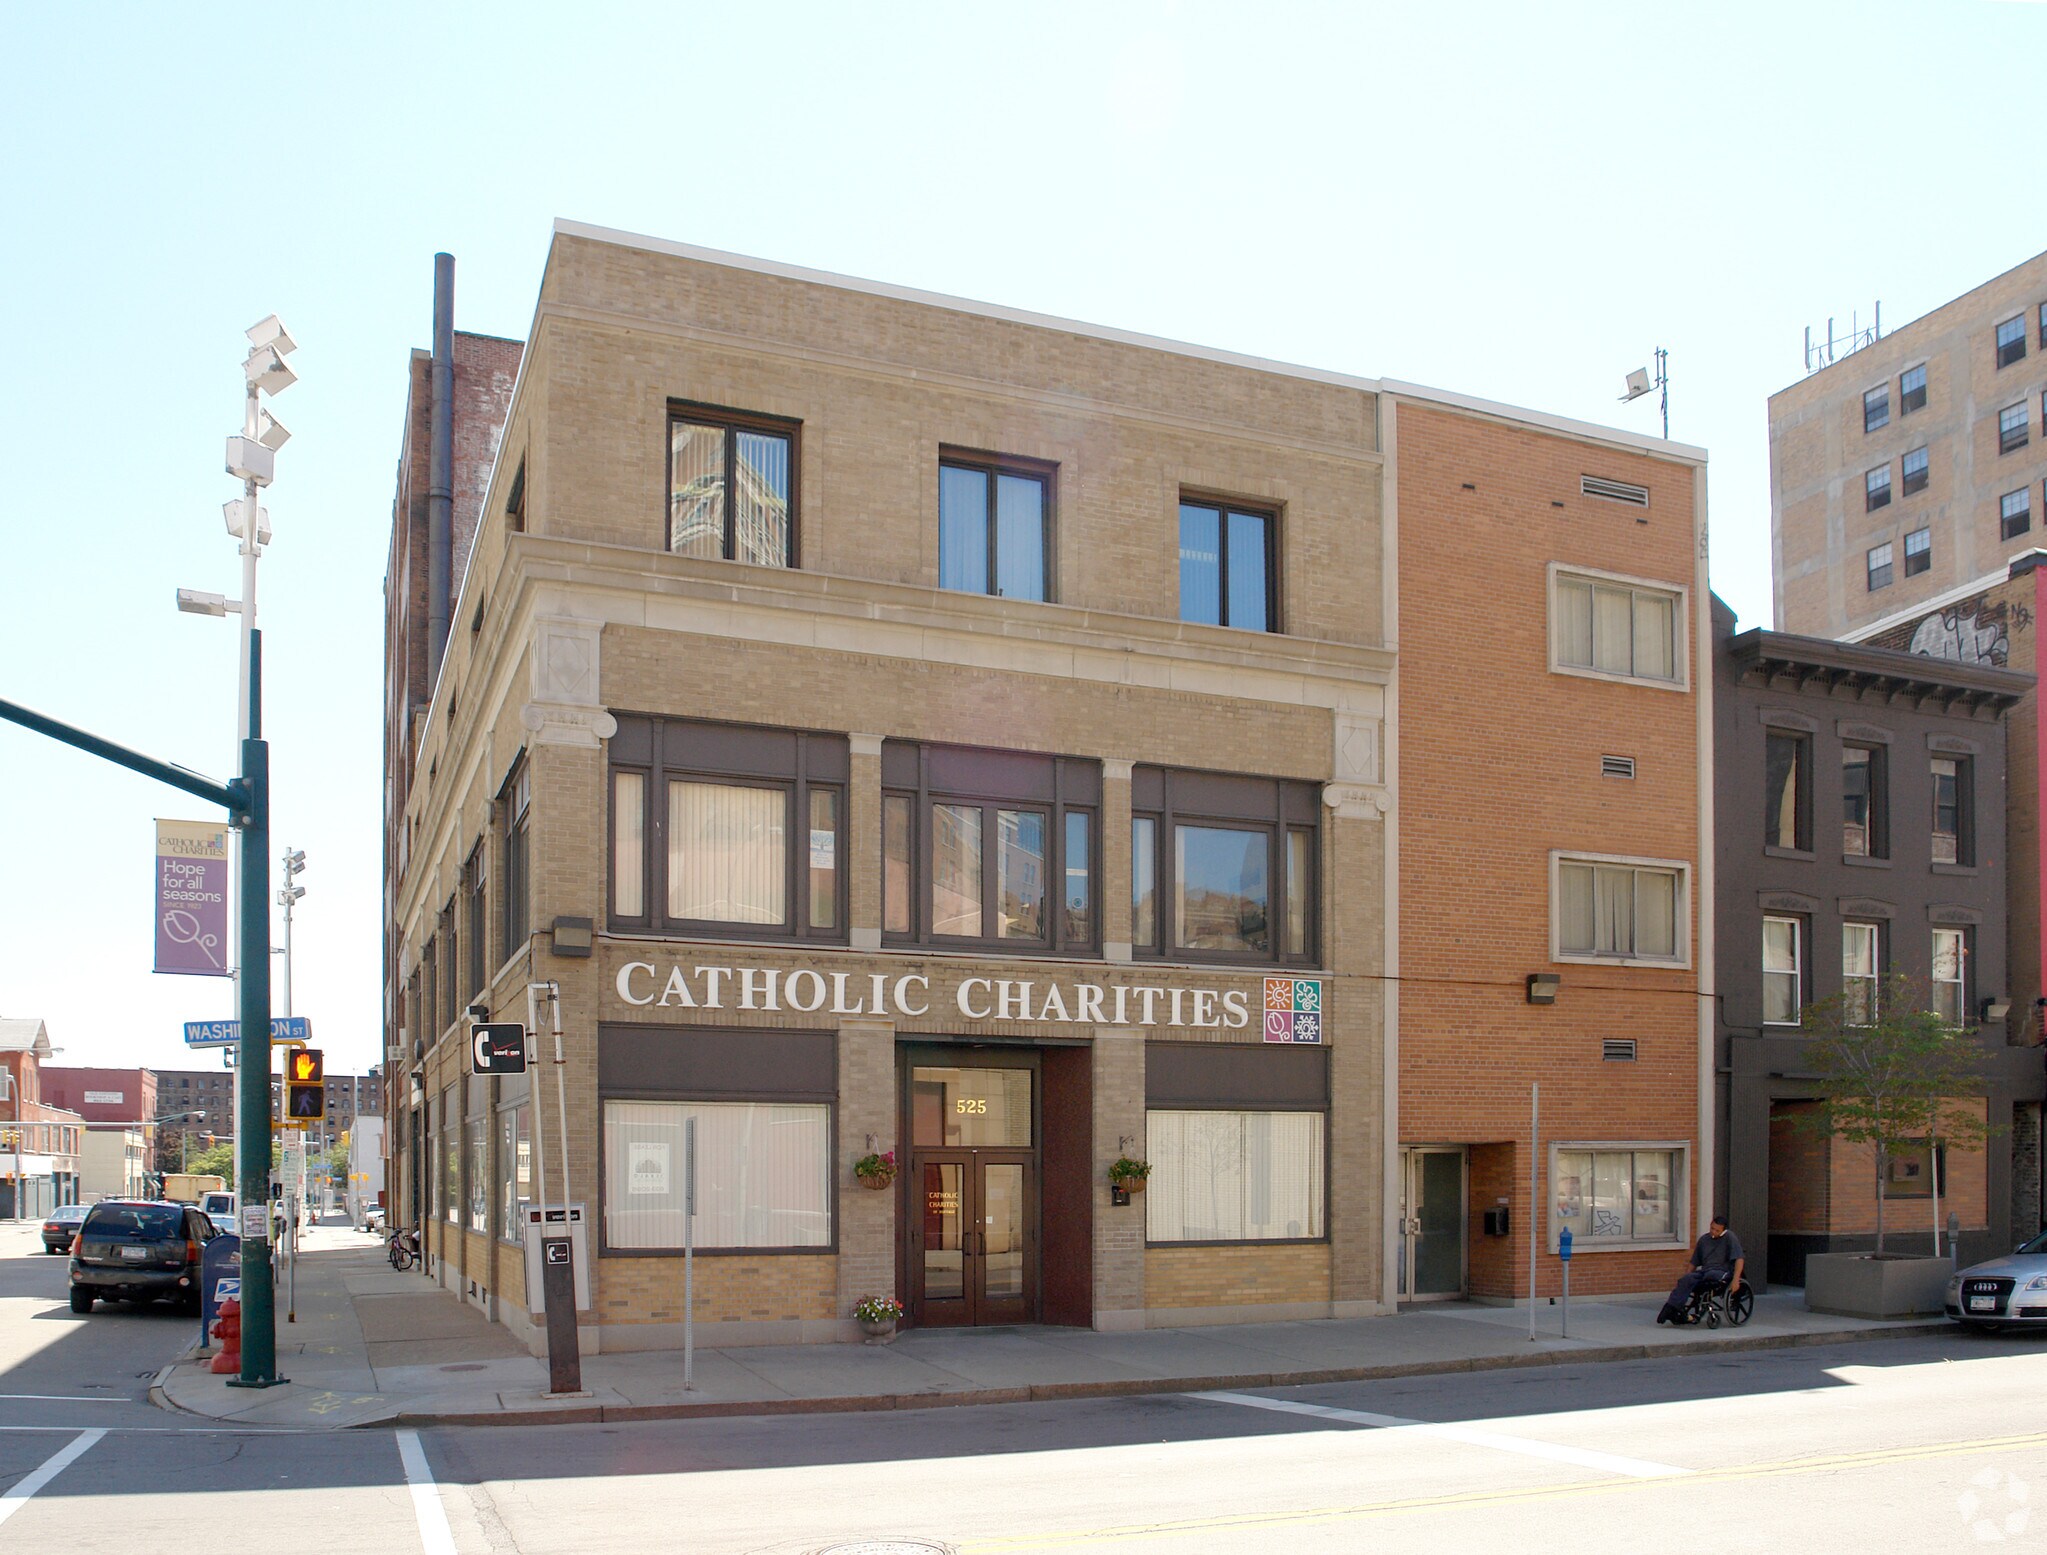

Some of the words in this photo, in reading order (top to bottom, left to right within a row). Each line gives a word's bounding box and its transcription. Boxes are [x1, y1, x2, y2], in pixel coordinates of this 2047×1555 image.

[158, 837, 206, 848] CATHOLIC
[173, 845, 224, 856] CHARITIES
[164, 860, 206, 878] Hope
[163, 874, 184, 888] for
[187, 875, 203, 889] all
[163, 890, 221, 902] seasons
[616, 961, 929, 1016] CATHOLIC
[957, 978, 1249, 1028] CHARITIES
[187, 1021, 290, 1040] WASHION
[293, 1026, 304, 1036] ST
[956, 1099, 987, 1114] 525
[928, 1191, 959, 1199] CATHOLIC
